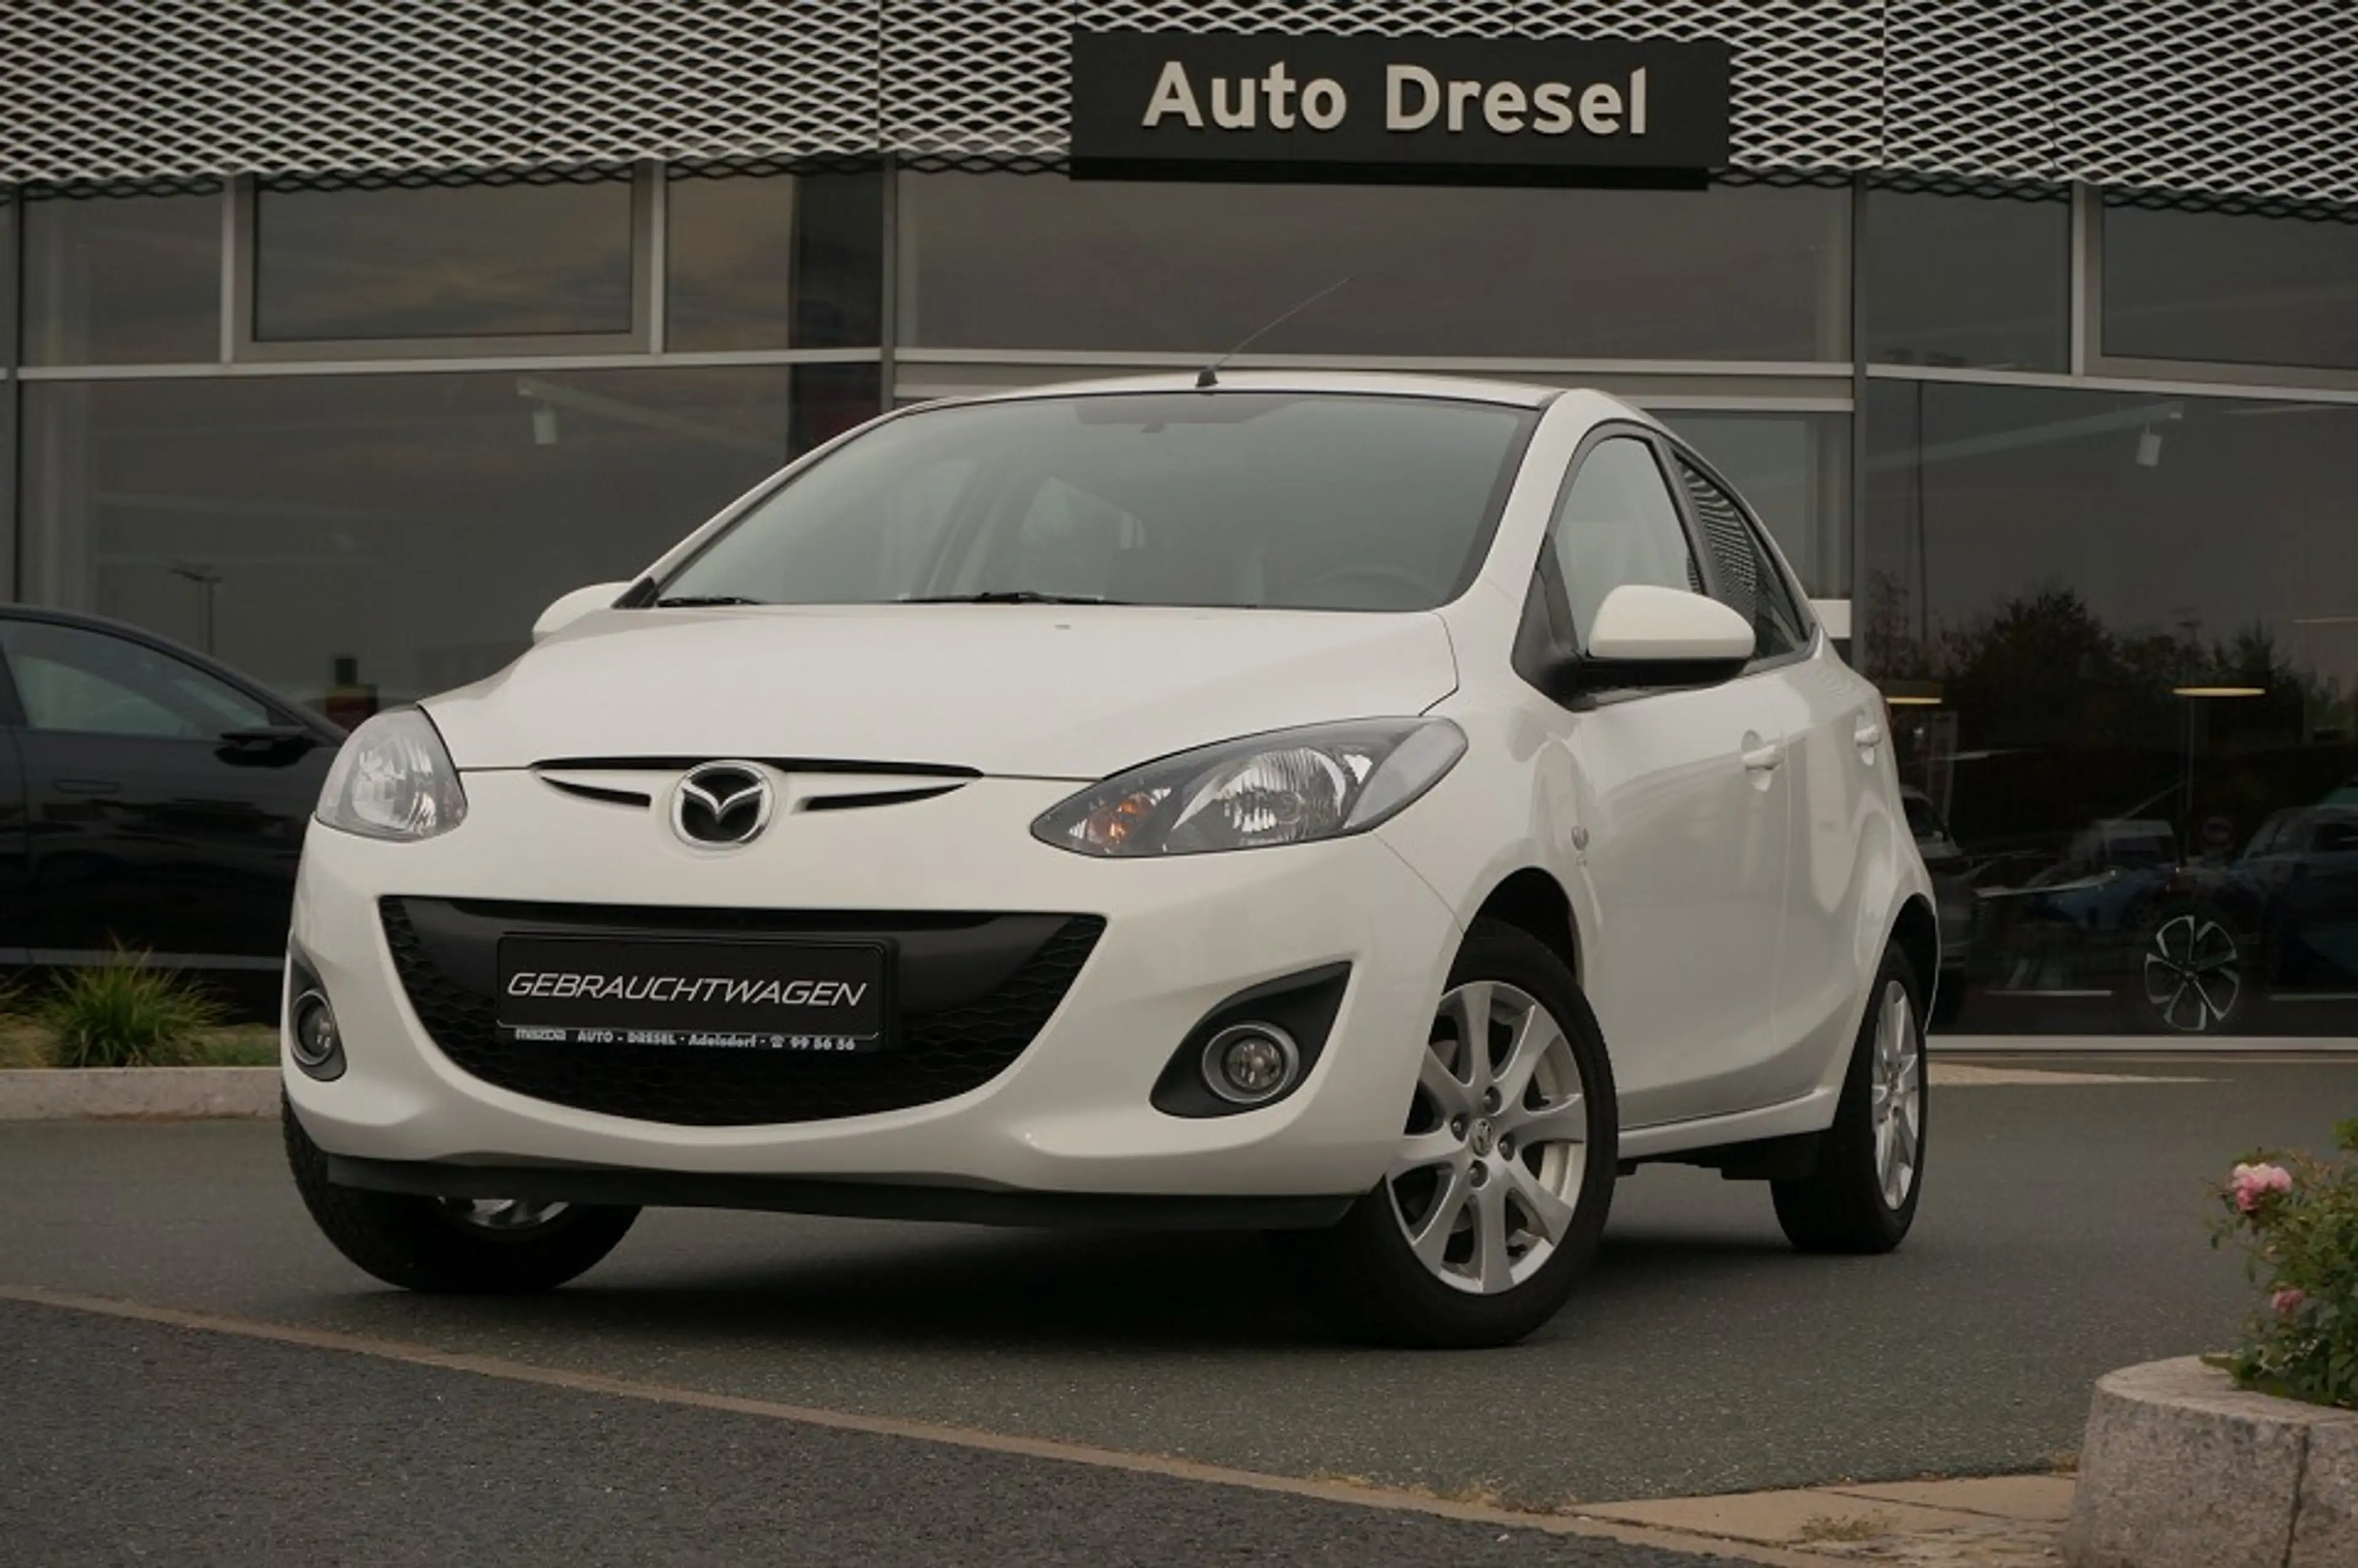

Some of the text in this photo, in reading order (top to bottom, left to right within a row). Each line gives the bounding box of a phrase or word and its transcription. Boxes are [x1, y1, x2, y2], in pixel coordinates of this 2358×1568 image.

[1142, 60, 1647, 134] Auto Dresel
[507, 972, 867, 1007] GEBRAUCHTWAGEN
[577, 1030, 613, 1042] AUTO
